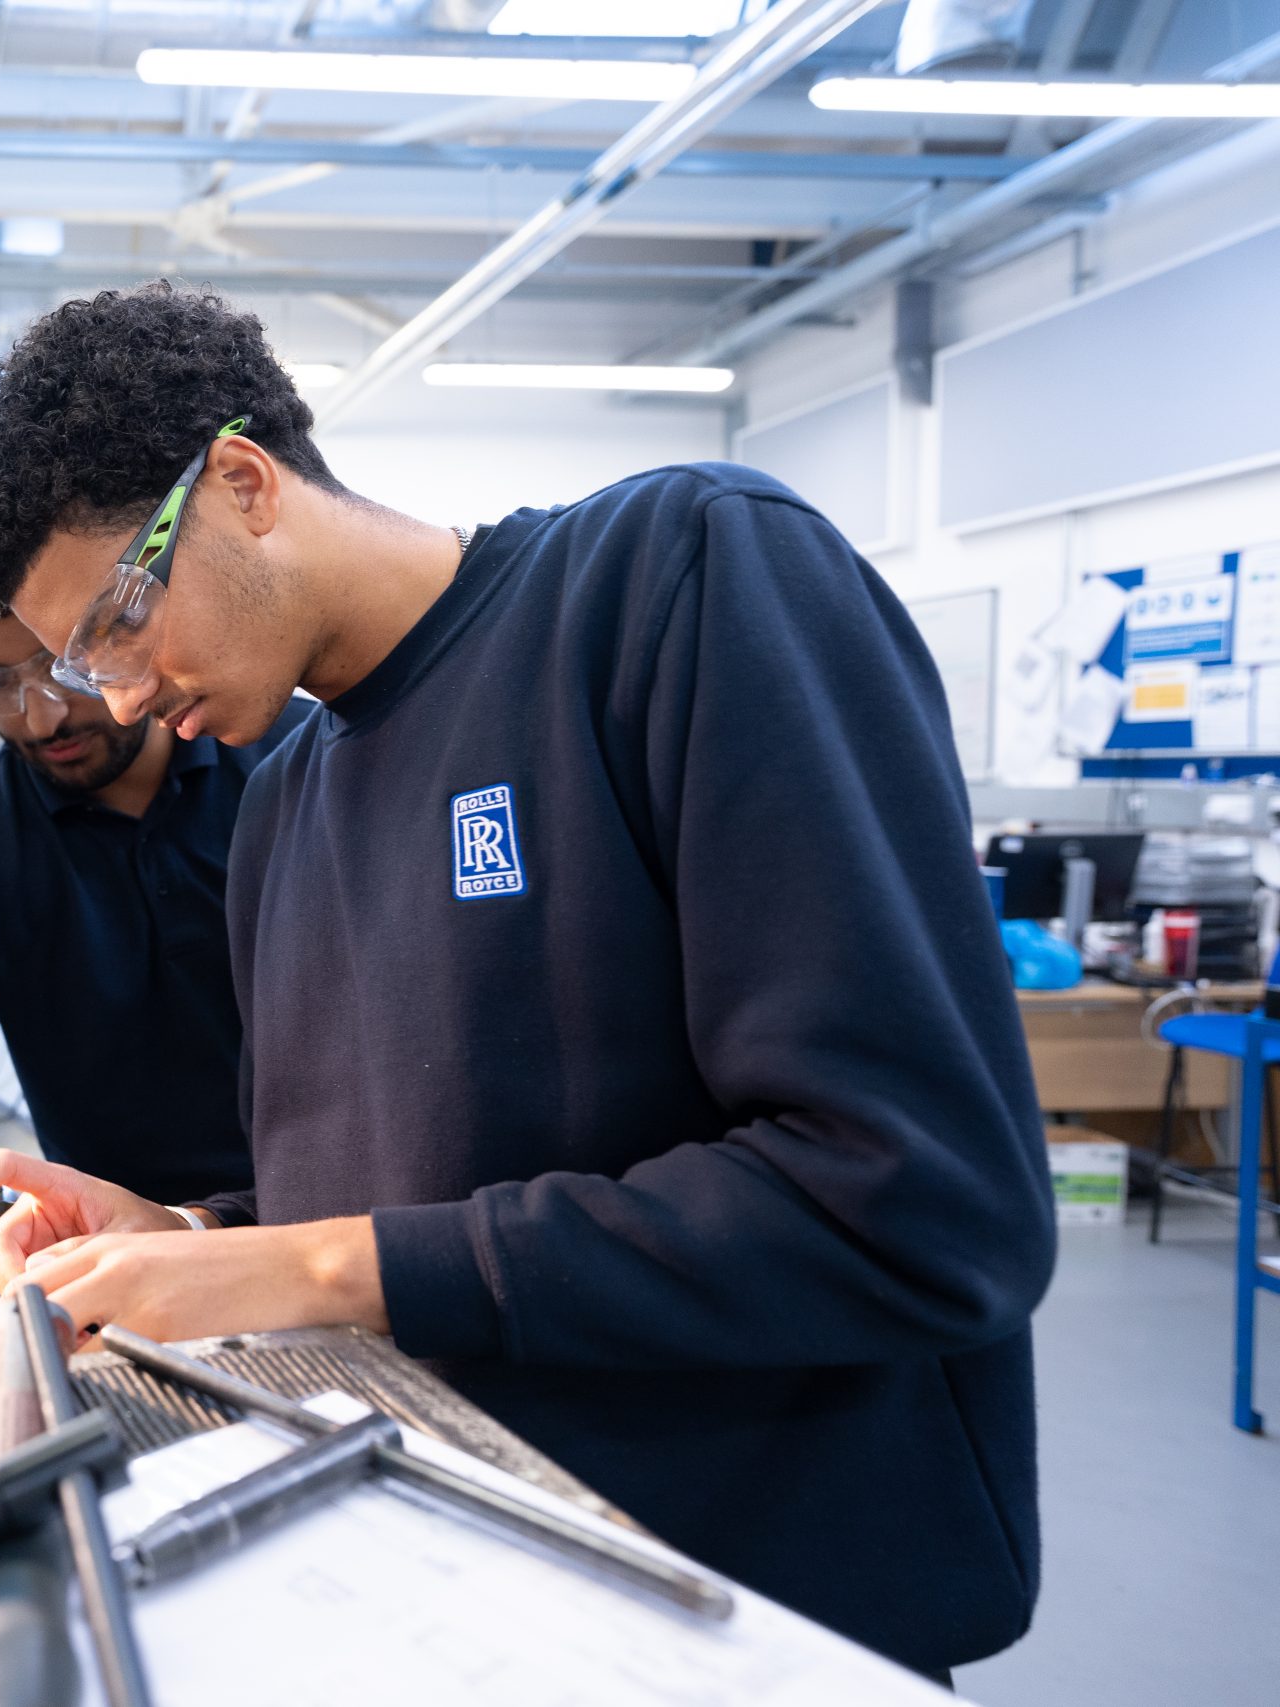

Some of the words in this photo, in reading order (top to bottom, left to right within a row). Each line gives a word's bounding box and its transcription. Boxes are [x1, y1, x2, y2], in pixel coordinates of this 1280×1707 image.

[458, 791, 504, 812] ROLLS
[460, 815, 511, 872] RR
[462, 875, 517, 893] ROYCE
